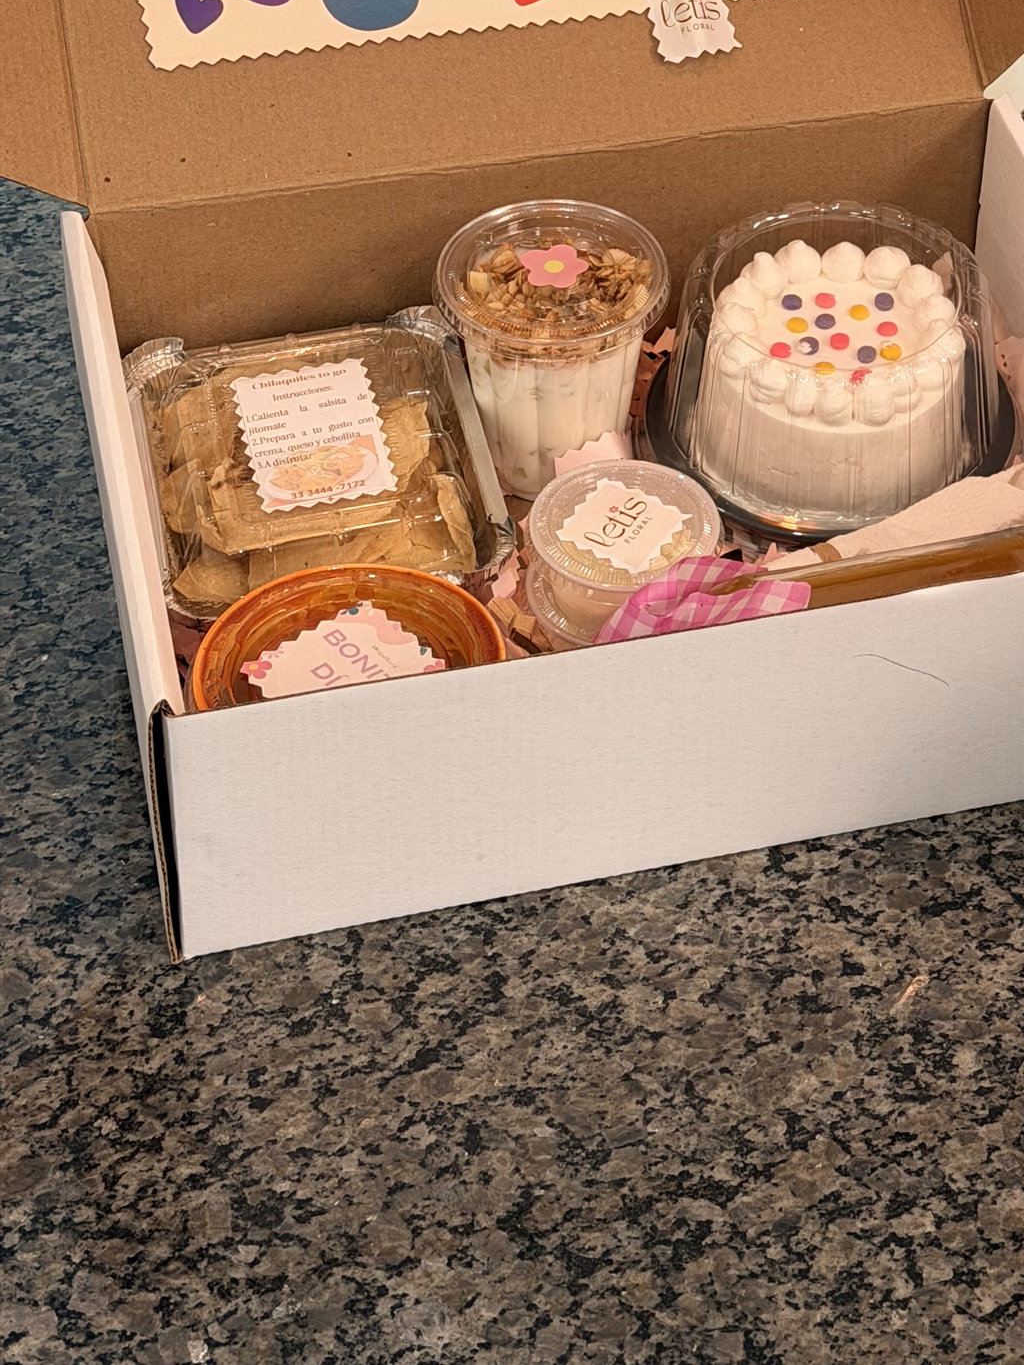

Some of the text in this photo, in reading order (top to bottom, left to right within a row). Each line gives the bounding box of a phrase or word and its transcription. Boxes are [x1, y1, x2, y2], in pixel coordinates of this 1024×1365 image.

[680, 23, 715, 35] FLORAL
[252, 369, 347, 390] Chilaquiles to go
[272, 385, 335, 402] Instrucciones:
[246, 392, 368, 423] 1.Calienta la salsita de
[248, 422, 287, 436] jitomate
[251, 433, 296, 447] 2.Prepara
[312, 427, 323, 435] tu
[328, 420, 353, 433] gusto
[357, 416, 375, 425] con
[254, 431, 361, 458] crema, queso y cebollita
[272, 452, 313, 467] disfrutar
[290, 491, 304, 500] 33
[306, 485, 333, 497] 3444
[583, 497, 648, 548] letis
[623, 515, 653, 545] FLORAL
[310, 661, 350, 687] DÍ
